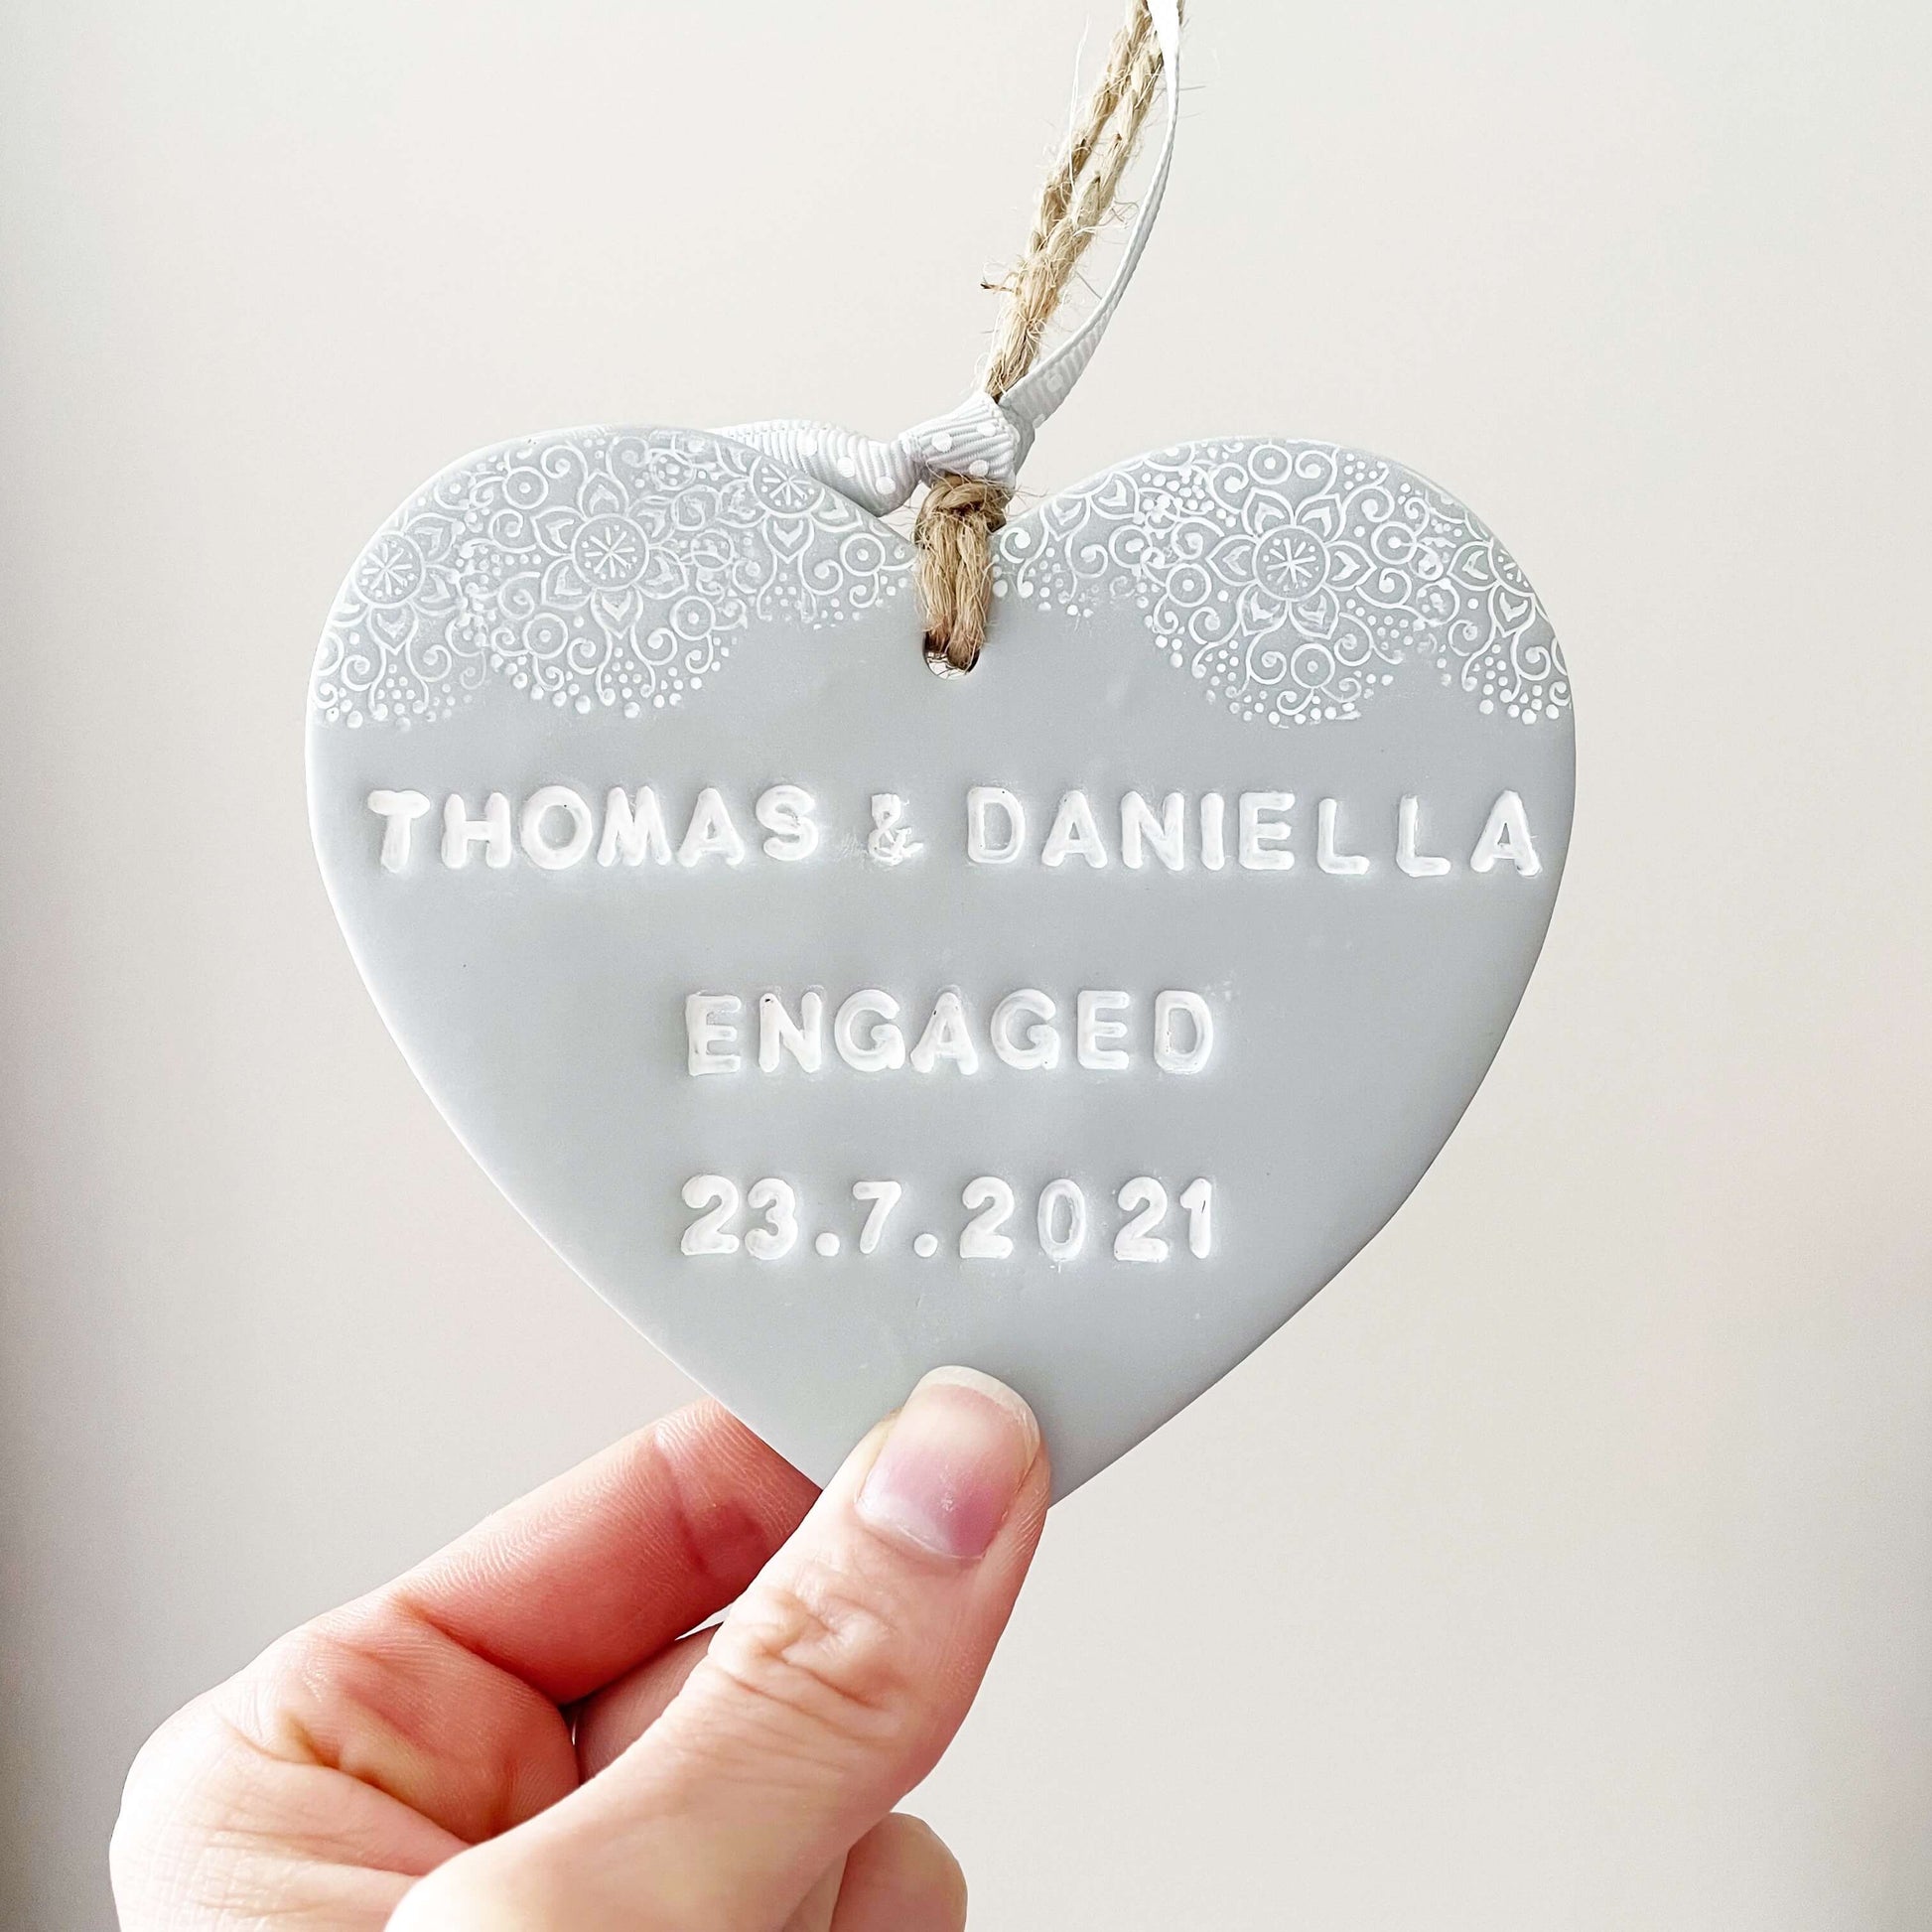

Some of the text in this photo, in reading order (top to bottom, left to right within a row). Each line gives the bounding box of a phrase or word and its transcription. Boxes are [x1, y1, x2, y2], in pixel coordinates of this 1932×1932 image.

[367, 785, 1543, 878] THOMAS & DANIELLA
[685, 989, 1214, 1076] ENGAGED
[681, 1173, 1212, 1262] 23.7.2021
